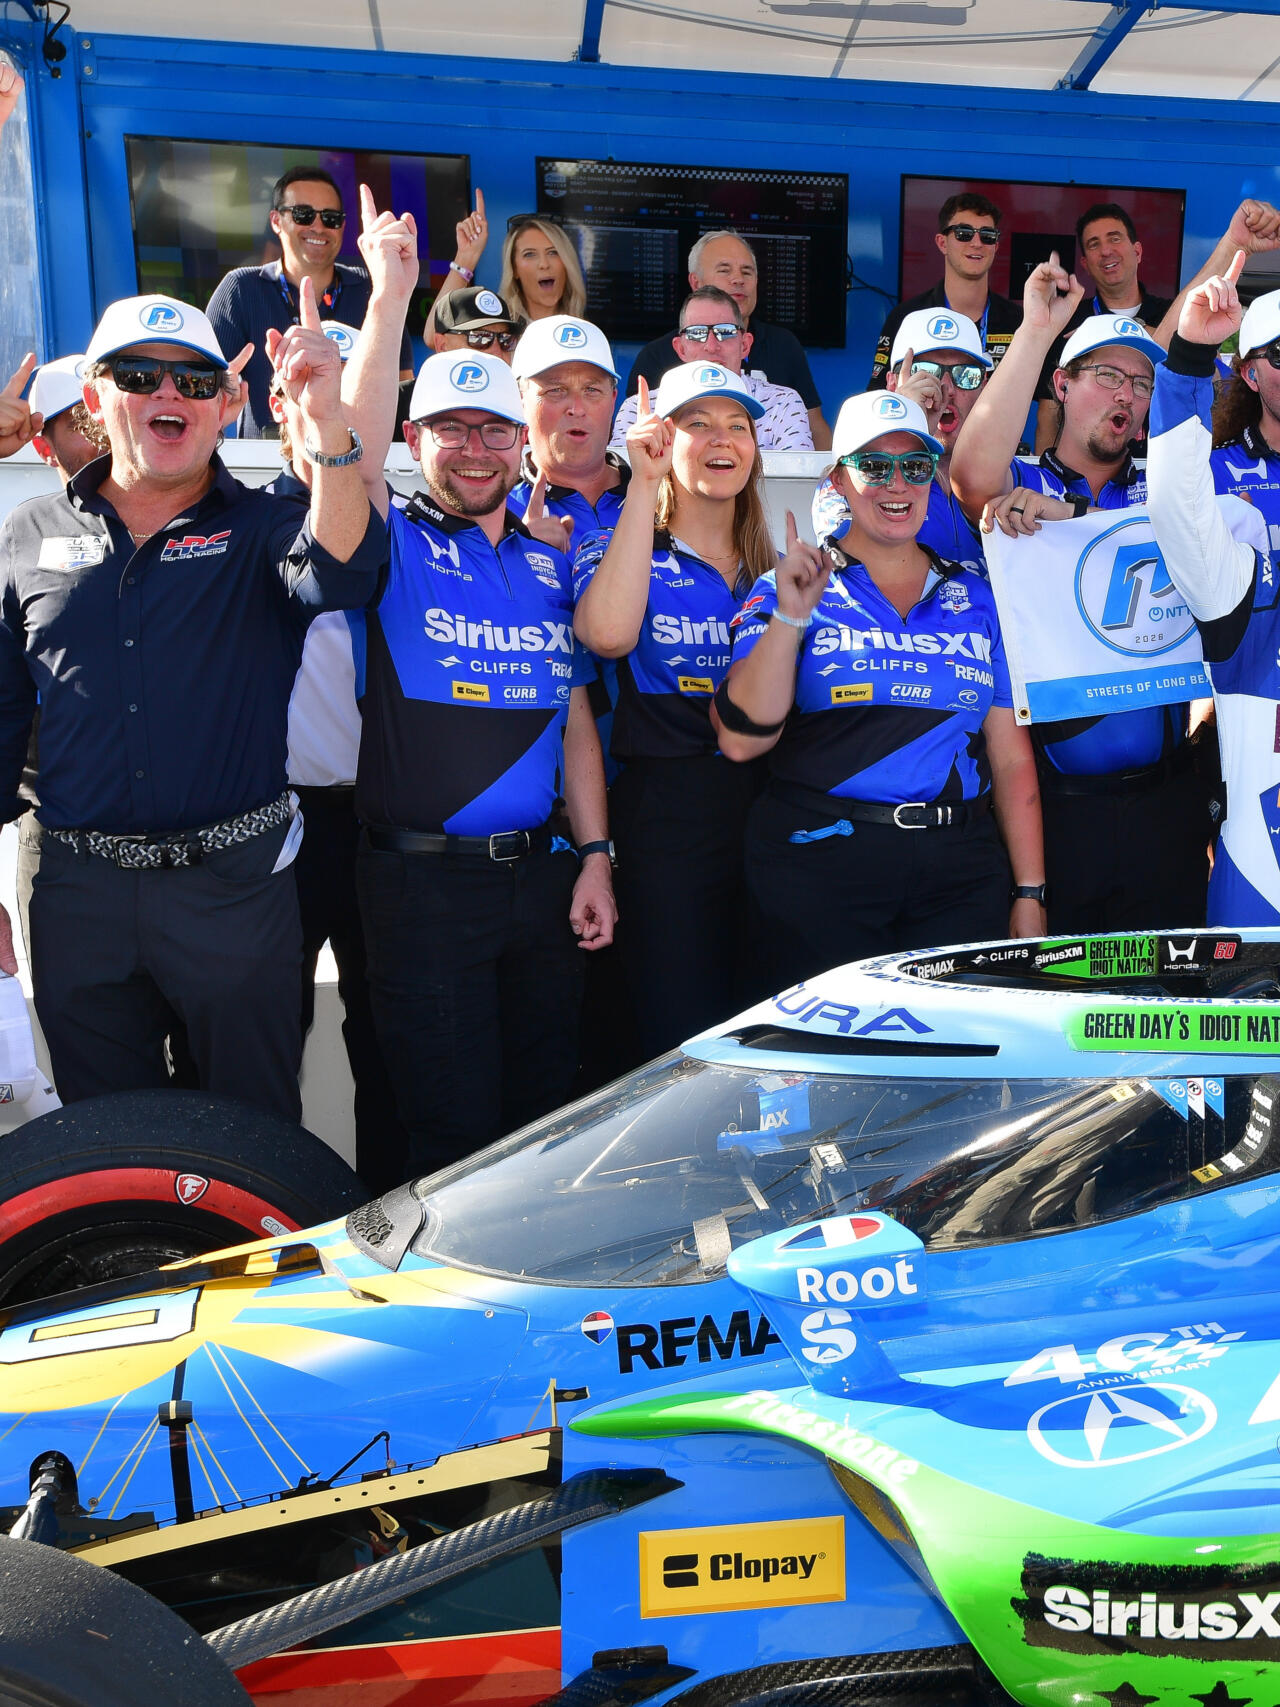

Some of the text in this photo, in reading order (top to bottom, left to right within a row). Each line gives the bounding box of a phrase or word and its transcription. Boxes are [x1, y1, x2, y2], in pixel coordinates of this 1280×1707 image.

[1228, 483, 1280, 493] Honda
[161, 529, 232, 558] HRC
[1165, 604, 1193, 619] NTT
[424, 607, 575, 656] SiriusX
[811, 623, 992, 666] SiriusXM
[470, 660, 532, 675] CLIFFS
[695, 655, 731, 667] CLIF
[851, 658, 928, 674] CLIFFS
[503, 688, 537, 699] CURB
[890, 685, 932, 699] CURB
[1086, 684, 1133, 698] STREETS
[1136, 681, 1151, 693] OF
[1155, 676, 1187, 689] LONG
[989, 949, 1029, 962] CLIFFS
[1034, 945, 1083, 966] SiriusXM
[1089, 936, 1155, 959] GREEN DAY'S
[1213, 941, 1237, 960] 60
[917, 959, 956, 979] REMAX
[1089, 959, 1114, 976] IDIOT
[1163, 962, 1200, 970] Honda
[772, 982, 935, 1036] URA
[1083, 1012, 1136, 1039] GREEN
[1139, 1009, 1190, 1041] DAY'S
[1199, 1014, 1242, 1042] IDIOT
[799, 1258, 918, 1304] Root
[616, 1309, 783, 1375] REMA
[1076, 1359, 1212, 1392] ANNIVERSARY
[722, 1389, 920, 1483] Firestone
[709, 1552, 818, 1586] Clopay
